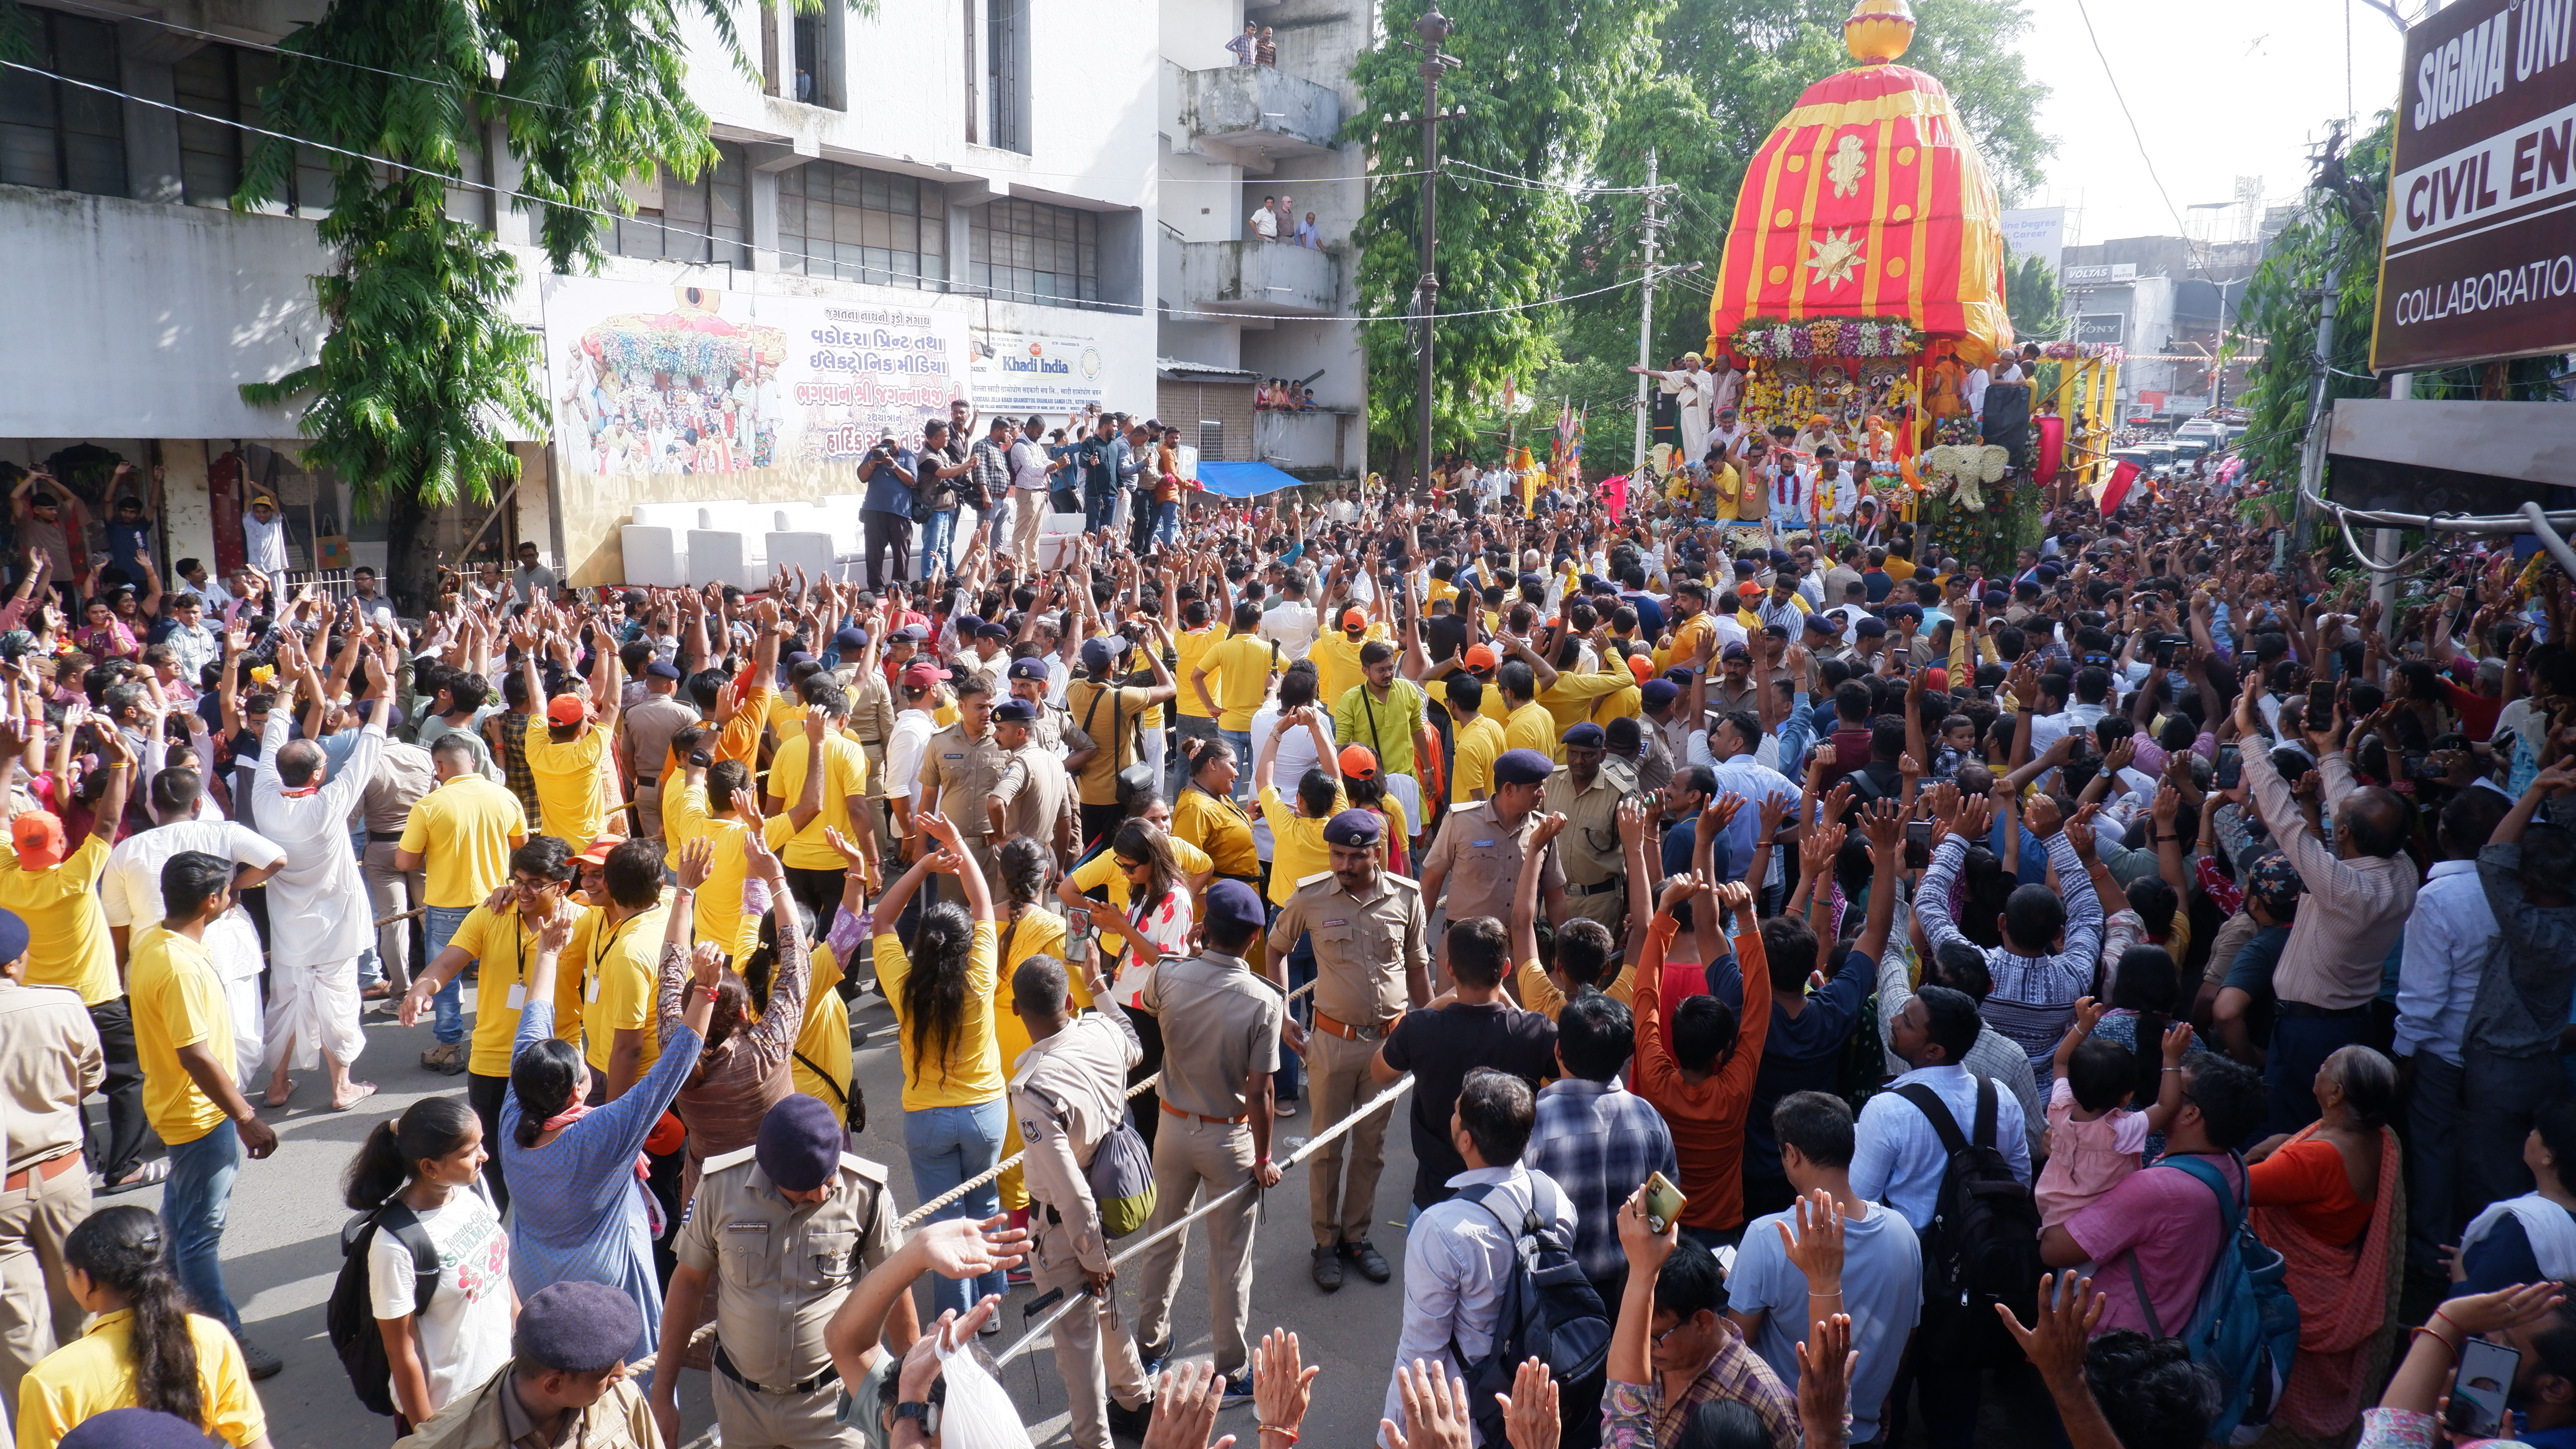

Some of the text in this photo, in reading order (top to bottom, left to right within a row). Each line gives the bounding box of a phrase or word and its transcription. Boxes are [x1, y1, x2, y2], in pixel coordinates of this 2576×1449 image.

[2415, 0, 2576, 131] SIGMA UNI
[2406, 118, 2576, 232] CIVIL EN
[2013, 230, 2047, 239] Career
[2021, 220, 2057, 230] Degree
[2069, 268, 2109, 279] VOLTAS
[2396, 255, 2576, 326] COLLABORATIO
[826, 309, 858, 321] જગતના
[861, 310, 889, 322] નાથનો
[905, 313, 930, 326] સંગાથ
[811, 325, 942, 351] વડોદરા પ્રિન્ટ તથા
[2079, 325, 2117, 333] SONY
[898, 355, 946, 374] મીડિયા
[1002, 355, 1037, 373] Khadi
[1040, 358, 1069, 374] India
[796, 385, 850, 403] ભગવાન
[854, 381, 872, 403] શ્રી
[875, 387, 944, 406] જગન્નાથજી
[987, 384, 999, 394] खादी
[1023, 385, 1039, 394] सहकारी
[1060, 387, 1072, 396] खादी
[867, 413, 902, 426] રથયાત્રાનું
[826, 426, 863, 454] હાર્દિક
[1182, 449, 1194, 473] P
[443, 1207, 486, 1249] Tomato-Girl
[444, 1213, 497, 1267] SUMMER
